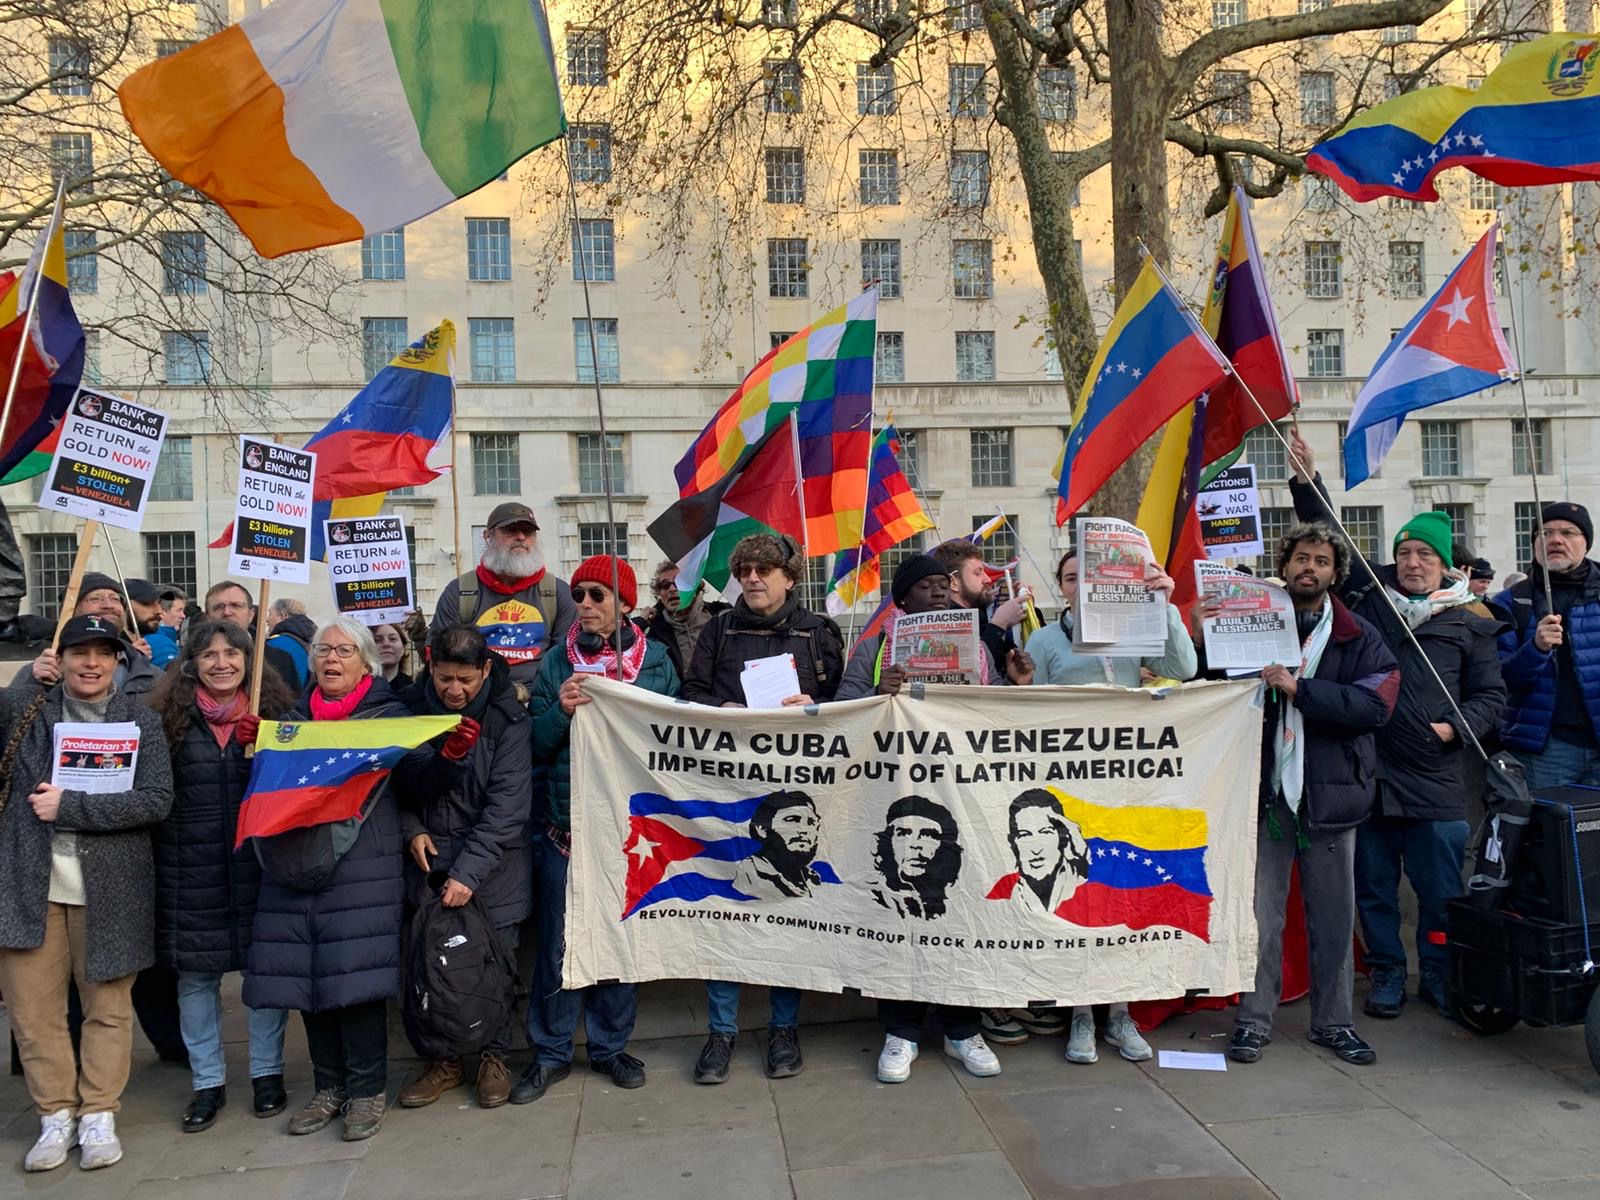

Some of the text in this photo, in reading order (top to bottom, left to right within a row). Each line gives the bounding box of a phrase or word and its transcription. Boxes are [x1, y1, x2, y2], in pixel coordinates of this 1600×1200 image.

[110, 401, 158, 425] BANK of
[102, 412, 158, 437] ENGLAND
[73, 422, 151, 455] RETURN the
[63, 438, 151, 471] GOLD NOW!
[269, 448, 297, 464] BANK
[73, 463, 131, 484] £3 billion+
[264, 461, 309, 480] ENGLAND
[1217, 470, 1229, 478] O
[77, 476, 125, 495] STOLEN
[244, 477, 306, 500] RETURN the
[1204, 477, 1250, 489] NCTIONS!
[75, 486, 131, 508] VENEZUELA
[1229, 492, 1247, 503] NO
[240, 495, 307, 518] GOLD NOW!
[1225, 505, 1253, 514] WAR!
[249, 520, 294, 536] £3 billion+
[355, 520, 386, 531] BANK
[1085, 522, 1114, 531] FIGHT
[1211, 518, 1240, 527] HANDS
[353, 530, 400, 541] ENGLAND
[1219, 527, 1236, 535] OFF
[254, 534, 290, 548] STOLEN
[253, 546, 298, 560] VENEZUELA
[335, 547, 401, 560] RETURN the
[333, 560, 405, 575] GOLD NOW!
[347, 580, 395, 591] £3 billion+
[1096, 585, 1125, 593] BUILD
[354, 589, 394, 600] STOLEN
[1092, 593, 1151, 603] RESISTANCE
[355, 598, 402, 609] VENEZUELA
[897, 612, 972, 628] FIGHT RACISM!
[1220, 613, 1275, 625] BUILD THE
[1216, 621, 1280, 633] RESISTANCE
[62, 740, 120, 750] Proletarian
[650, 723, 1180, 758] VIVA CUBA VIVA VENEZUELA
[648, 751, 1183, 785] IMPERIALISM OUT OF LATIN AMERICA!
[639, 908, 1184, 950] REVOLUTIONARY COMMUNIST GROUP ROCK AROUND THE BLOCKADE
